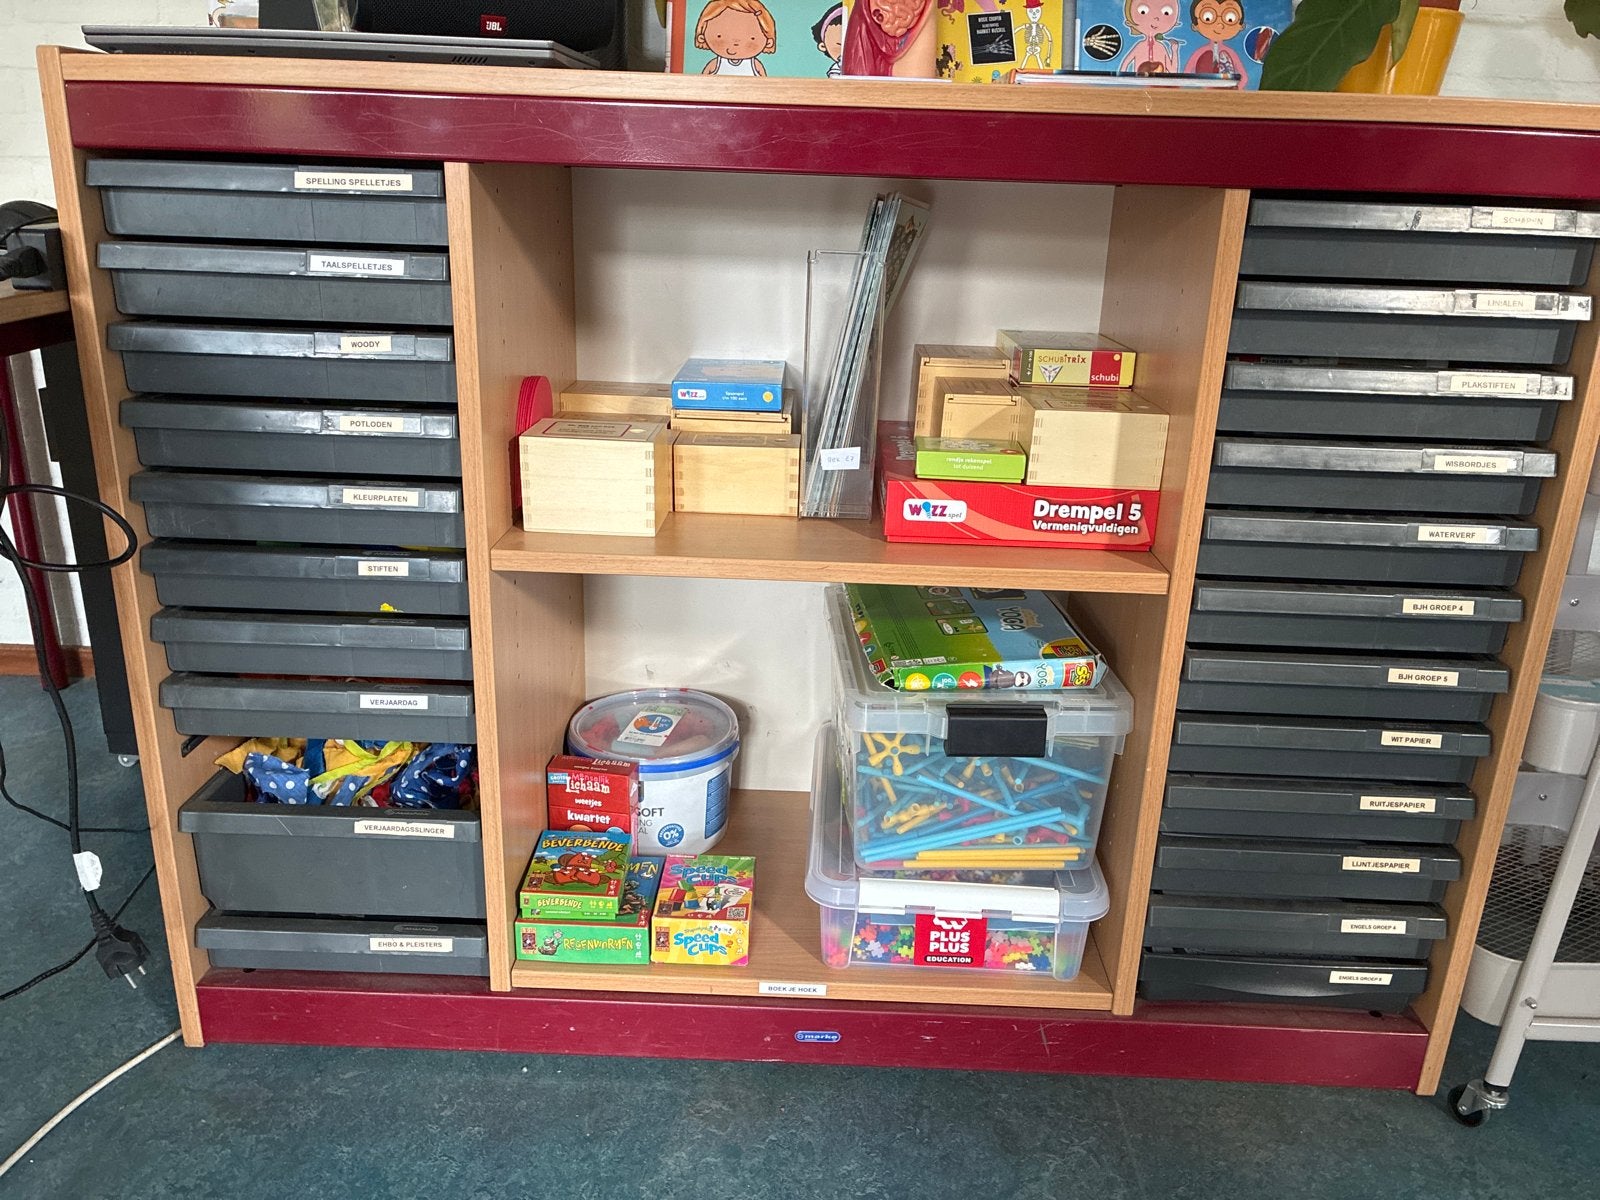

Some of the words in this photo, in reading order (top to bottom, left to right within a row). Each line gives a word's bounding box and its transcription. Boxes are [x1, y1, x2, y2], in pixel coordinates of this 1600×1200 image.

[486, 21, 502, 31] JBL
[305, 177, 347, 186] SPELLING
[348, 178, 402, 187] SPELLETJES
[321, 260, 393, 271] TAALSPELLETJES
[350, 340, 381, 348] WOODY
[1091, 373, 1119, 382] schubi
[1461, 381, 1517, 390] PLAKSTIFTEN
[349, 420, 393, 428] POTLODEN
[1445, 460, 1497, 469] WISBORDJES
[352, 493, 409, 503] KLEURPLATEN
[948, 510, 963, 520] spel
[1033, 500, 1123, 521] Drempel
[1128, 502, 1142, 521] 5
[1032, 520, 1139, 536] Vermenigvuldigen
[1428, 531, 1476, 539] WATERVERF
[367, 565, 399, 573] STIFTEN
[1412, 603, 1428, 611] BJH
[1429, 604, 1458, 612] GROEP
[999, 606, 1026, 631] YOGA
[1397, 673, 1413, 681] BJH
[1414, 674, 1442, 682] GROEP
[1443, 675, 1448, 683] 5
[369, 698, 419, 707] VERJAARDAG
[1404, 737, 1432, 745] PAPIER
[591, 758, 631, 768] Lichaam
[565, 777, 610, 794] Lichaam
[574, 798, 603, 808] weetjes
[1369, 801, 1426, 809] RUITJESPAPIER
[566, 809, 611, 825] kwartet
[363, 824, 446, 835] VERJAARDAGSSLINGER
[663, 828, 679, 840] 0%
[542, 837, 626, 852] BEVERBENDE
[1351, 861, 1411, 869] LIJNTJESPAPIER
[669, 863, 729, 879] Speed
[685, 873, 738, 884] Cups
[537, 897, 582, 909] BEVERBENDE
[673, 932, 719, 949] Speed
[929, 930, 971, 943] PLUS
[405, 941, 443, 949] PLEISTERS
[562, 936, 634, 951] REGENWORMEN
[687, 943, 728, 956] Cups
[725, 940, 734, 949] 2
[929, 941, 970, 953] PLUS
